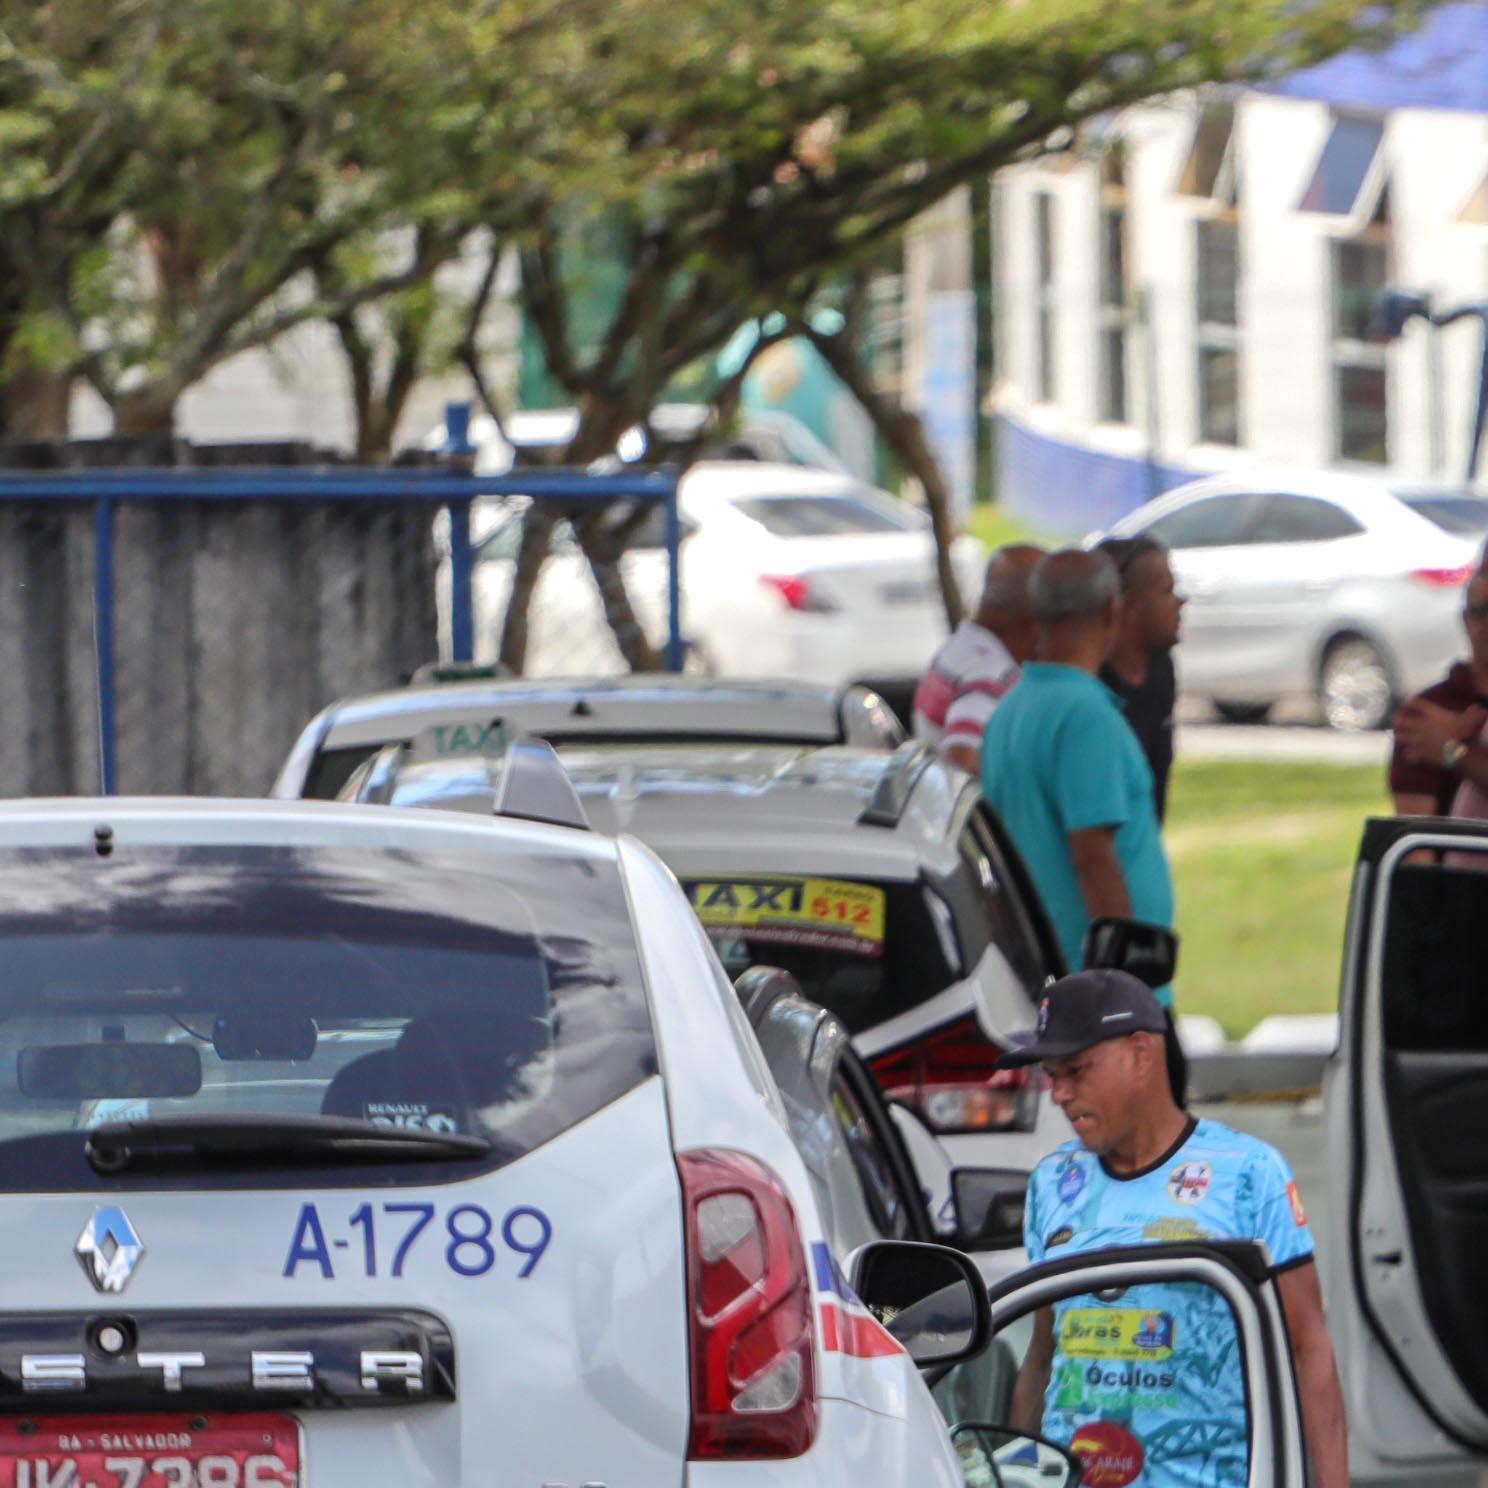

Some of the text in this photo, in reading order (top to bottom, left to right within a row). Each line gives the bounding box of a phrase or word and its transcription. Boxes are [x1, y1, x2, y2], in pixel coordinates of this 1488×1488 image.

[433, 715, 508, 753] TAXI
[811, 896, 871, 923] 512
[368, 1103, 428, 1114] RENAULT
[283, 1202, 552, 1279] A-1789
[20, 1350, 424, 1391] STER
[1085, 1360, 1174, 1388] Óculos
[100, 1432, 192, 1449] SALVADOR
